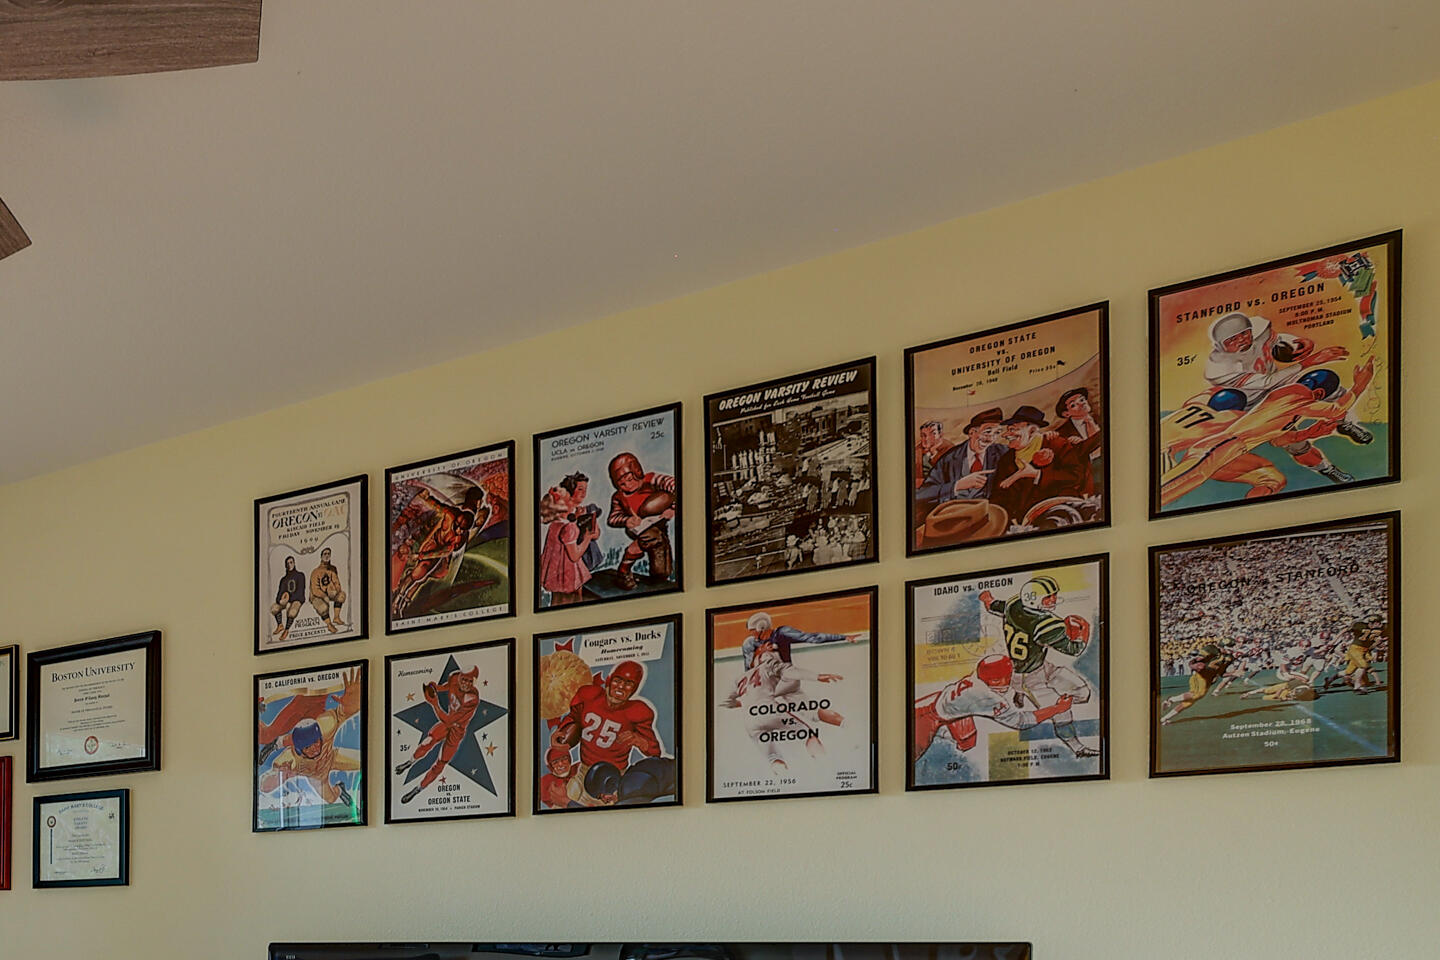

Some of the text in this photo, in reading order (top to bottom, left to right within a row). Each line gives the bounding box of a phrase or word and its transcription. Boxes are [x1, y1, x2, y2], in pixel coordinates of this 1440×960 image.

[1176, 282, 1325, 324] STANFORD vs. OREGON
[1279, 302, 1314, 315] SEPTEMBER
[1325, 308, 1352, 319] STADIUM
[1304, 319, 1334, 330] PORTLAND
[969, 332, 1037, 354] OREGON STATE
[951, 345, 1056, 376] UNIVERSITY OF OREGON
[1002, 364, 1018, 373] Field
[718, 370, 858, 411] OREGON VARSITY REVIEW
[551, 417, 665, 448] OREGON VARSITY REVIEW
[551, 448, 568, 456] UCLA
[577, 441, 605, 451] OREGON
[272, 511, 318, 529] OREGON
[934, 585, 959, 596] IDAHO
[978, 578, 1013, 590] OREGON
[1187, 564, 1360, 594] OREGON STANFORD
[584, 638, 617, 648] Cougars
[635, 630, 661, 641] Ducks
[601, 645, 643, 654] Homecoming
[52, 662, 135, 683] BOSTON UNIVERSITY
[275, 677, 306, 688] CALIFORNIA
[318, 672, 340, 682] OREGON
[398, 667, 433, 677] Homecoming
[749, 699, 830, 716] COLORADO
[581, 712, 622, 748] 25
[1230, 721, 1273, 730] September
[759, 728, 819, 742] OREGON
[437, 784, 461, 792] OREGON
[427, 795, 471, 805] OREGON STATE
